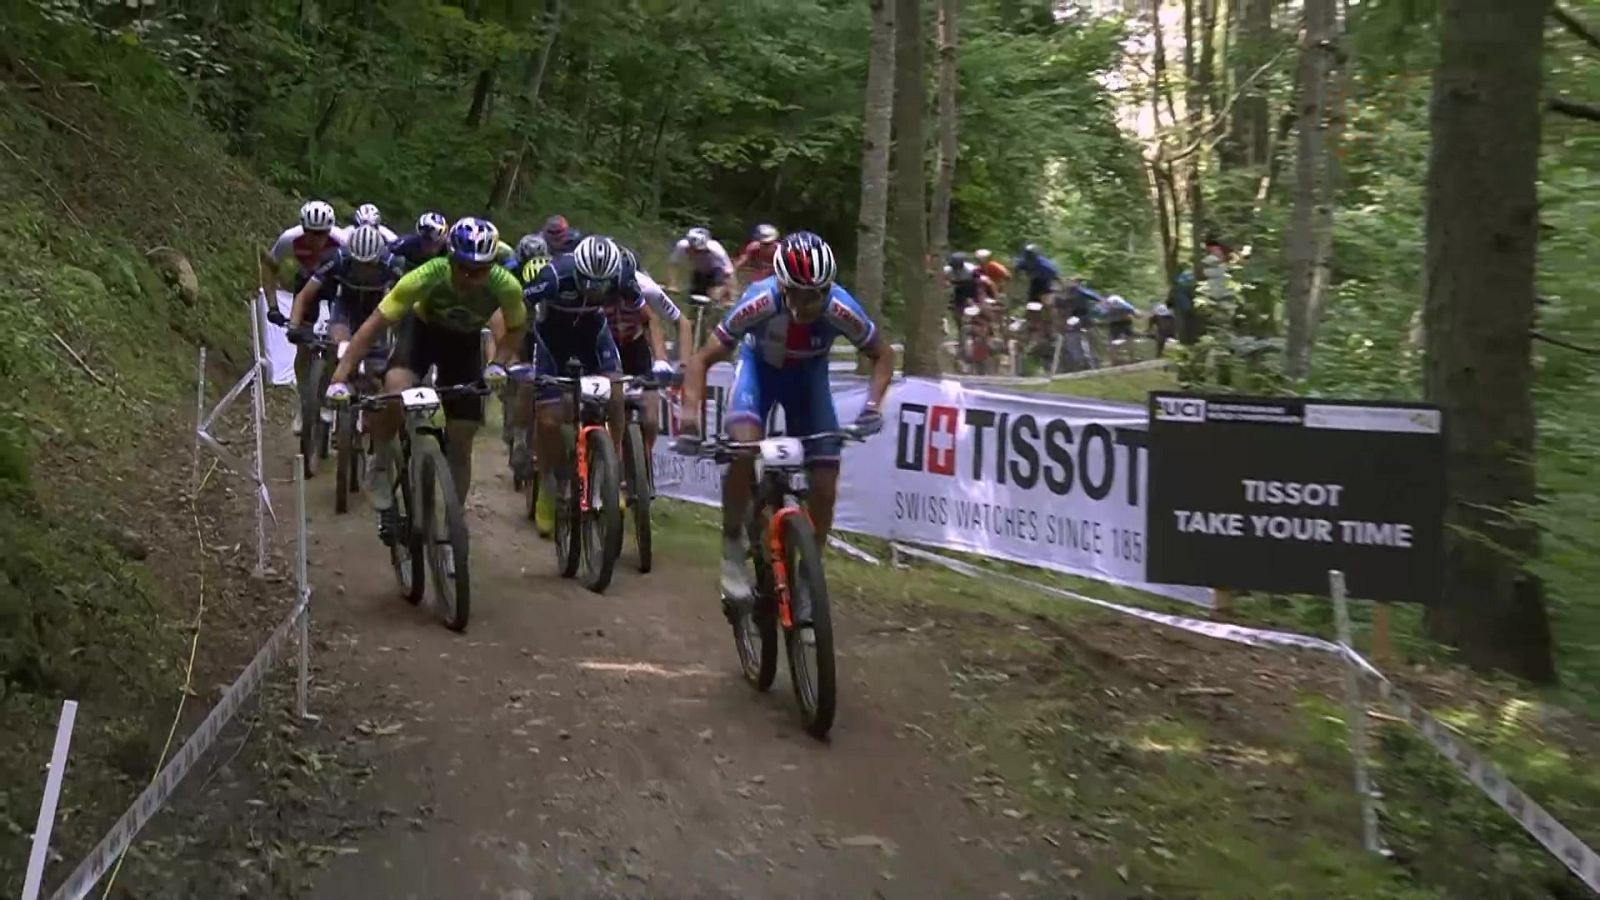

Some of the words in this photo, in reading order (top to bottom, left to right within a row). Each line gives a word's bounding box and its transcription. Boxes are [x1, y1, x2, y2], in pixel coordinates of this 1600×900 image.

[414, 389, 425, 400] 4
[590, 382, 600, 394] 7
[1163, 400, 1202, 417] UCI
[776, 445, 789, 459] 5
[965, 408, 1149, 507] TISSOT
[1242, 478, 1344, 507] TISSOT
[895, 491, 949, 526] SWISS
[956, 499, 1038, 543] WATCHES
[1045, 514, 1103, 555] SINCE
[1174, 509, 1244, 537] TAKE
[1250, 516, 1333, 543] YOUR
[1338, 520, 1414, 548] TIME
